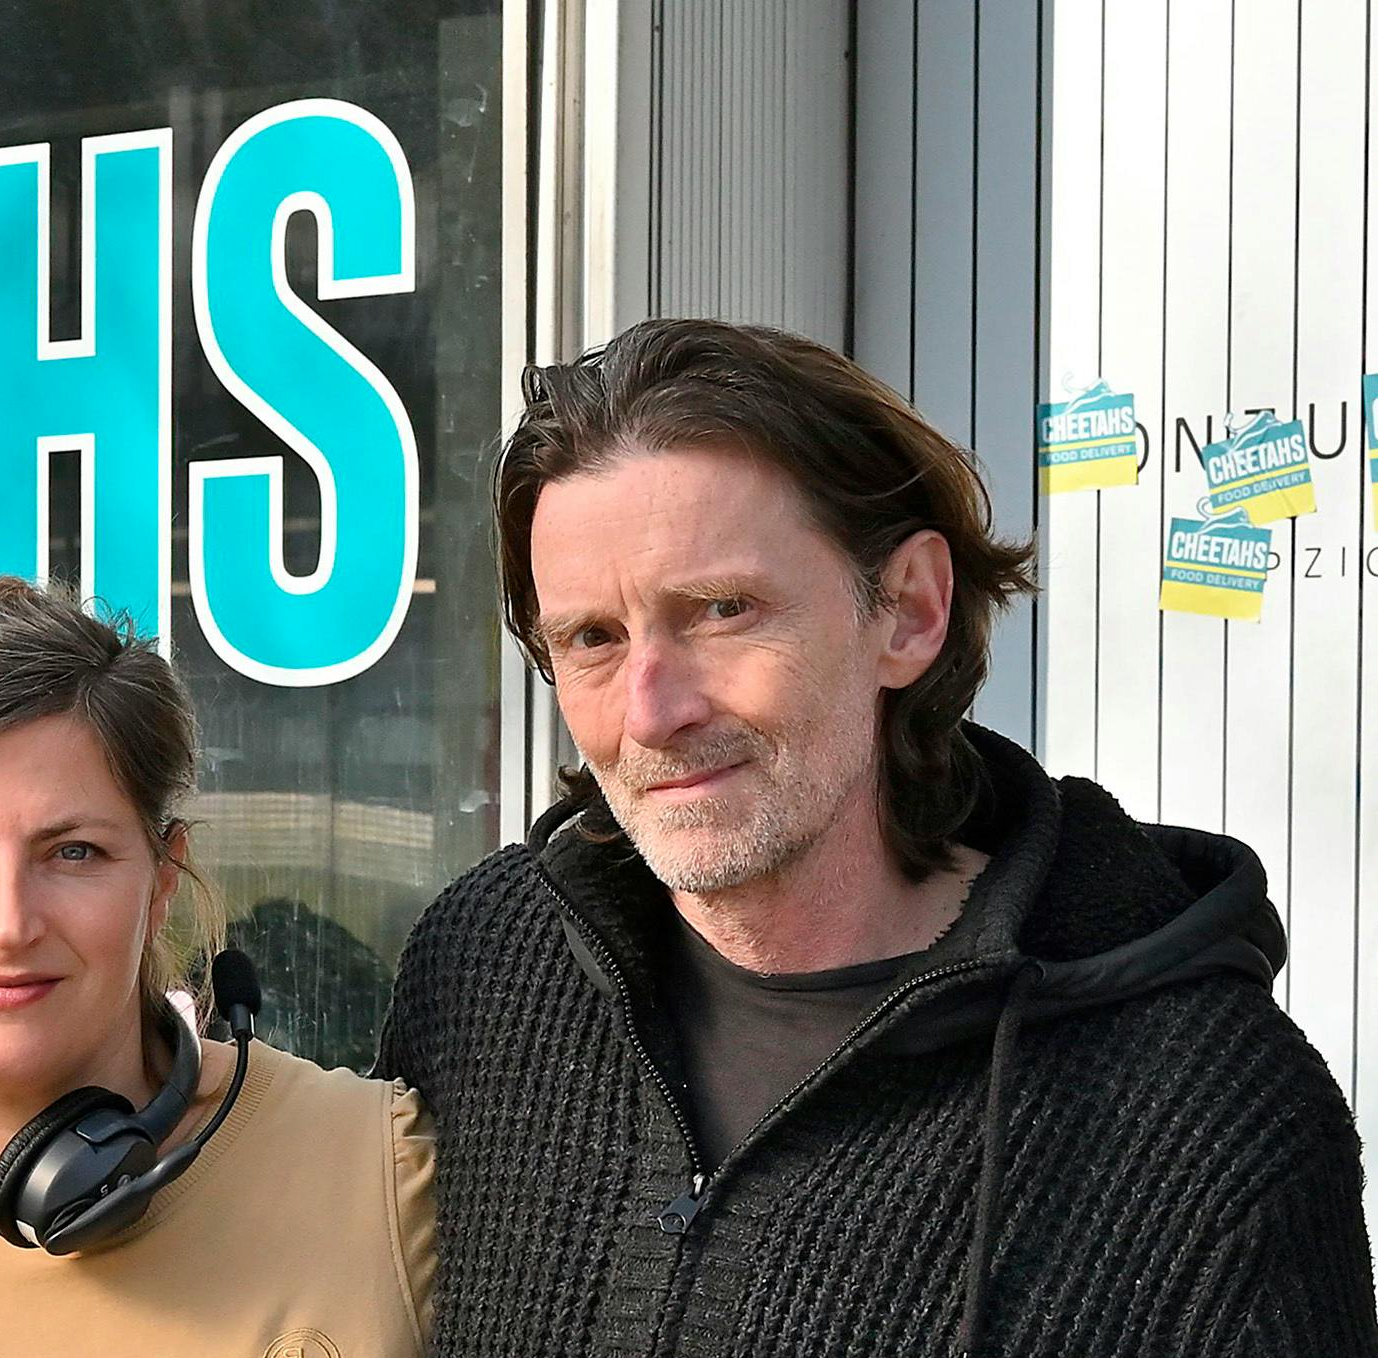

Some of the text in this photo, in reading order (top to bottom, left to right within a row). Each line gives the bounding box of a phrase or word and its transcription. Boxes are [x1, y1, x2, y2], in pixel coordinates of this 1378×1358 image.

[1042, 406, 1135, 443] CHEETAHS
[1080, 443, 1132, 460] DELIVERY
[1208, 434, 1305, 484] CHEETAHS
[1218, 472, 1306, 503] FOOD DELIVERY
[1171, 531, 1267, 569] CHEETAHS
[1171, 569, 1259, 590] FOOD DELIVERY
